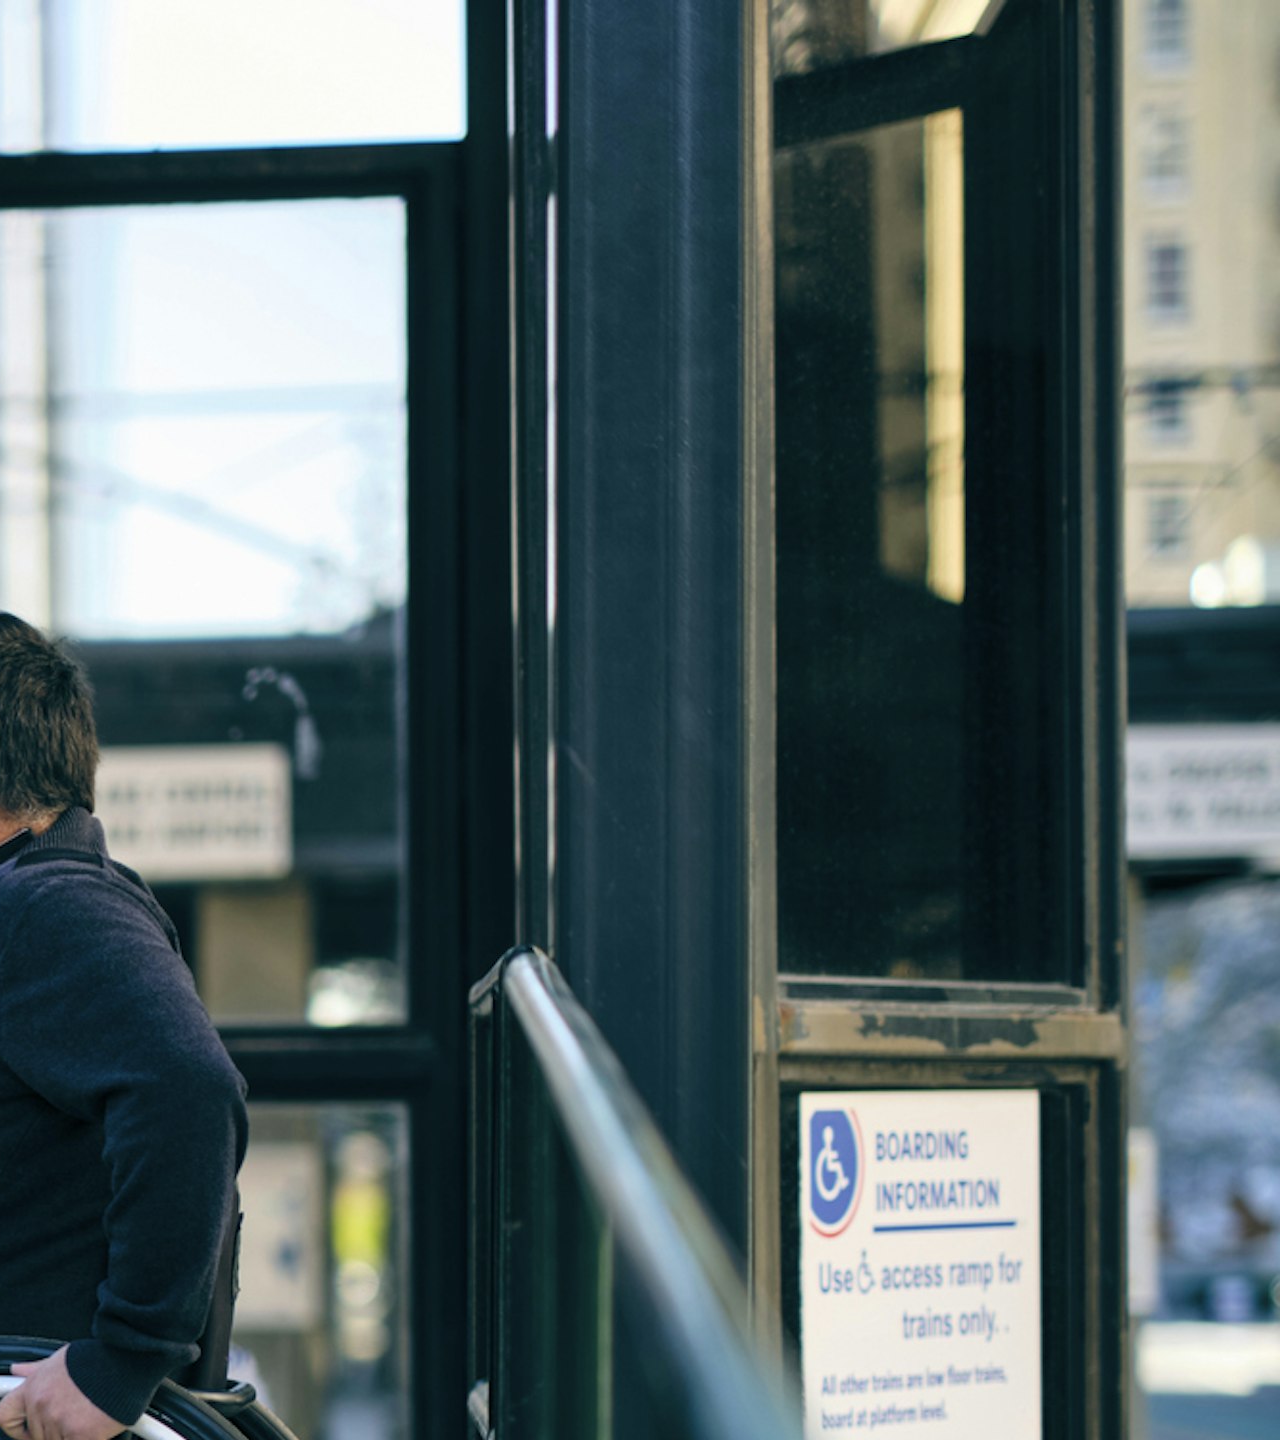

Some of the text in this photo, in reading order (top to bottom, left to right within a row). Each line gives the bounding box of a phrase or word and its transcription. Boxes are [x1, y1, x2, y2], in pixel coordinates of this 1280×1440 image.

[876, 1131, 968, 1161] BOARDING
[876, 1179, 999, 1211] INFORMATION
[819, 1252, 1023, 1294] Use access ramp for
[903, 1307, 953, 1340] trains
[822, 1375, 836, 1395] All
[840, 1374, 869, 1395] other
[873, 1371, 904, 1392] trains
[907, 1373, 925, 1390] are
[927, 1368, 945, 1387] low
[948, 1364, 973, 1386] floor
[822, 1407, 854, 1430] board
[856, 1408, 868, 1428] at
[871, 1403, 917, 1430] platform
